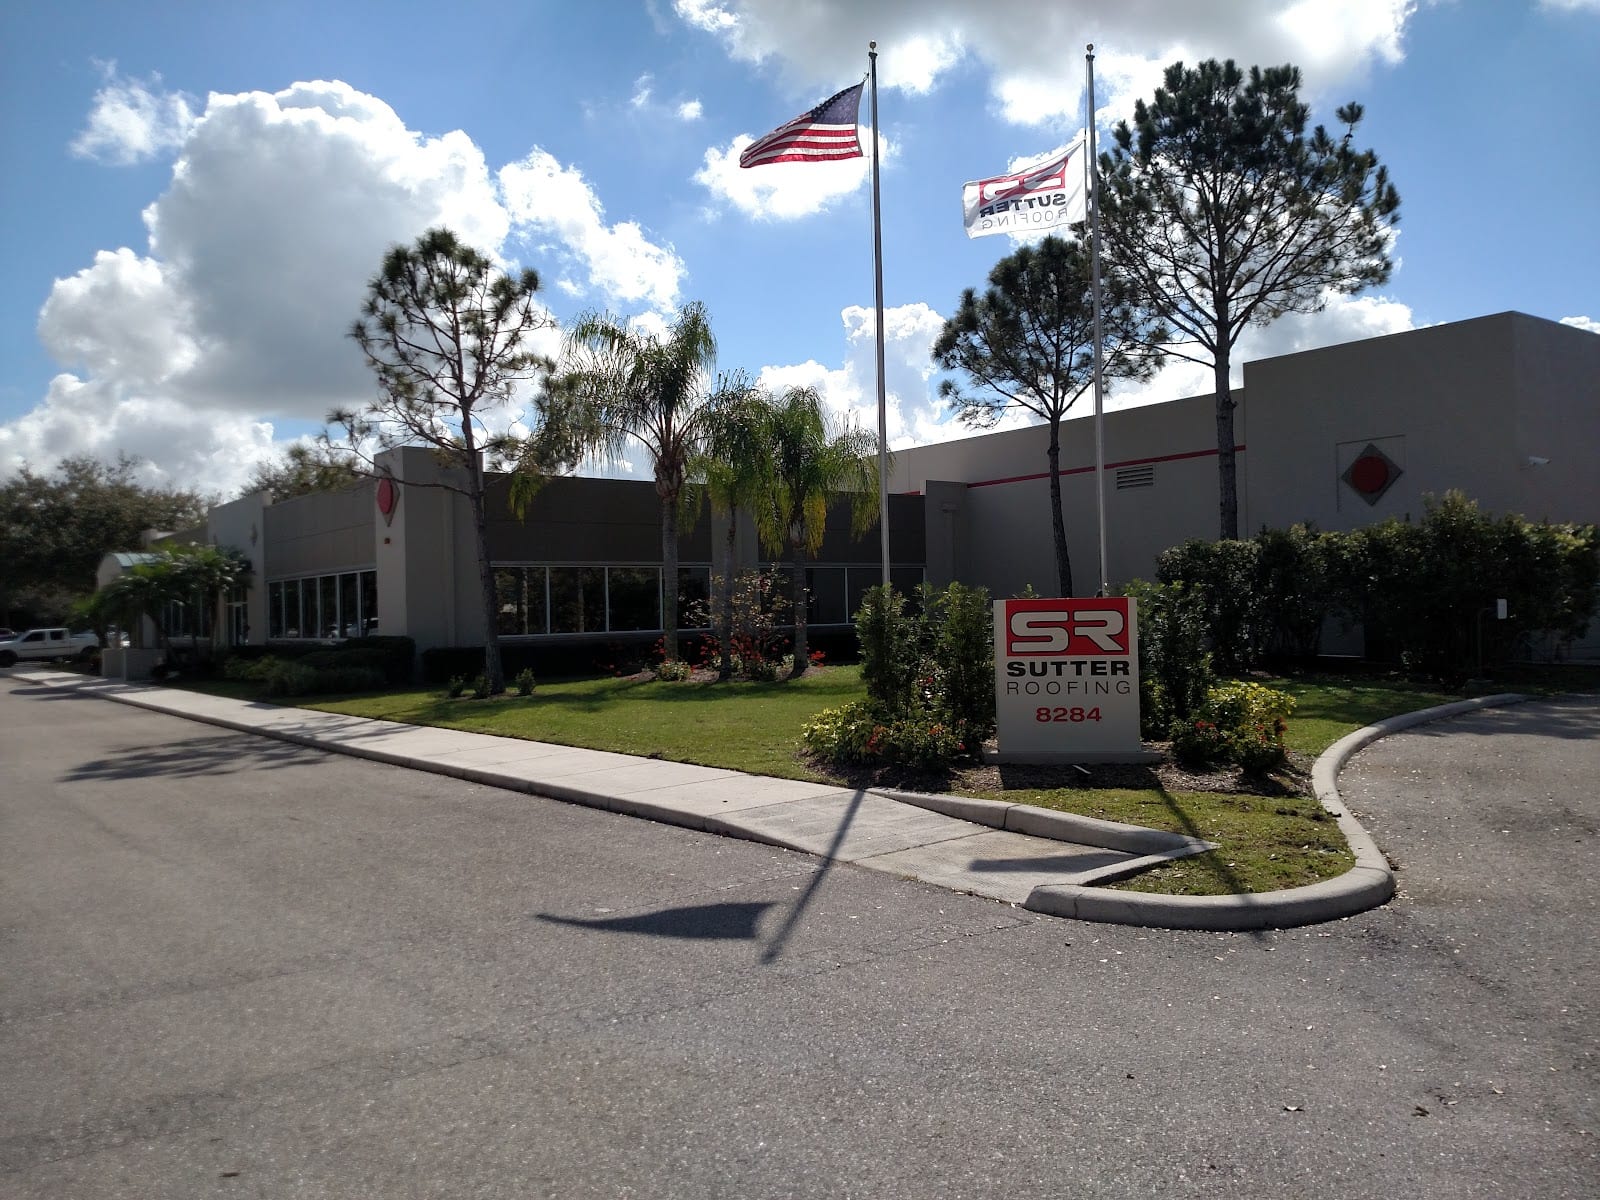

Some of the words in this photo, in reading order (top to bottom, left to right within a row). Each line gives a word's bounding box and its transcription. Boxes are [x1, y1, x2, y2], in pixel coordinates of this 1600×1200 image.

[1010, 610, 1125, 653] SR
[1006, 660, 1130, 677] SUTTER
[1006, 680, 1131, 695] ROOFING
[1035, 707, 1102, 723] 8284
